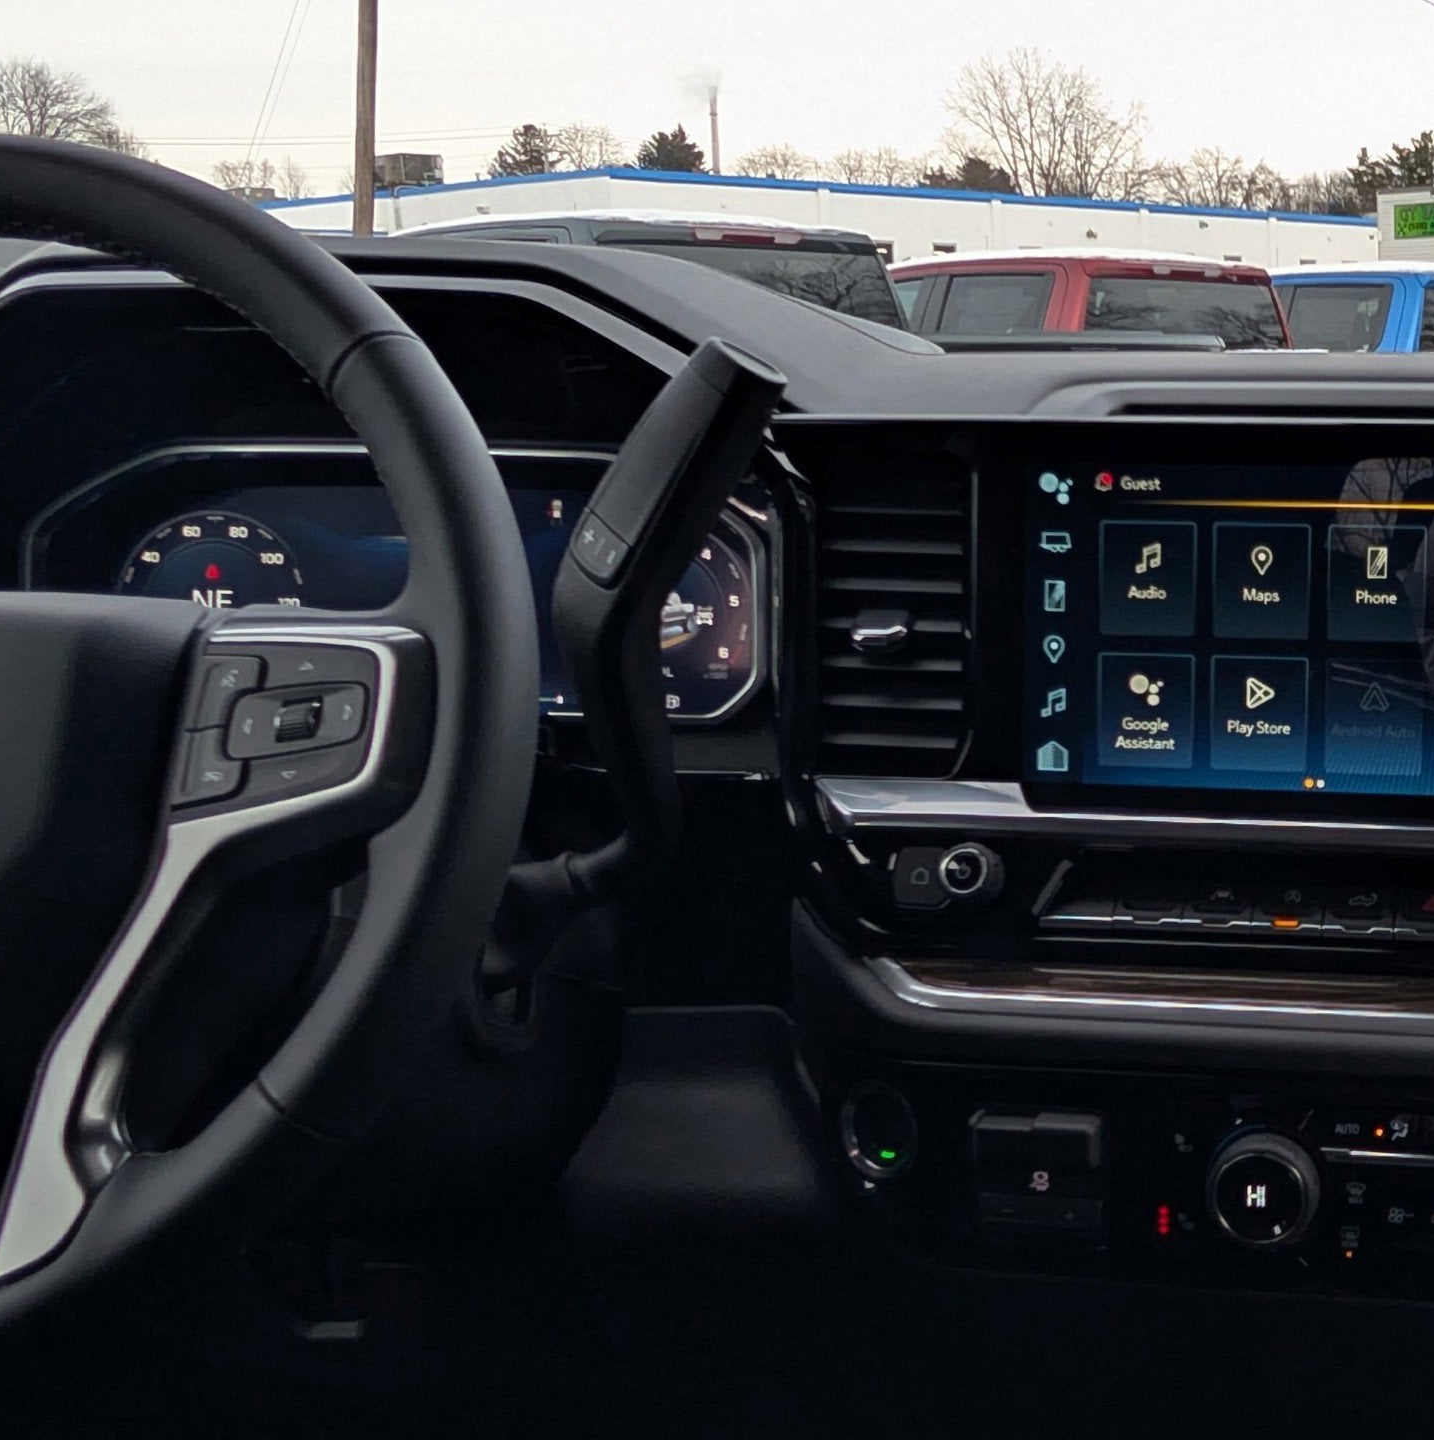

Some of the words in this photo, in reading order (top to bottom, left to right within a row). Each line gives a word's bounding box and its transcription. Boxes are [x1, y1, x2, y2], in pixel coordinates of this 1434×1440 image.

[1120, 475, 1162, 493] Guest
[181, 525, 202, 538] 60
[228, 525, 250, 538] 80
[141, 551, 161, 564] 40
[259, 552, 285, 565] 100
[700, 547, 713, 561] 4
[1126, 584, 1167, 601] Audio
[1242, 587, 1281, 606] Maps
[1354, 589, 1399, 607] Phone
[727, 594, 741, 608] 5
[717, 646, 730, 660] 6
[1121, 717, 1170, 736] Google
[1226, 720, 1256, 737] Play
[1255, 720, 1292, 736] Store
[1114, 736, 1176, 752] Assistant
[1334, 1122, 1361, 1136] AUTO
[1245, 1183, 1267, 1209] HI
